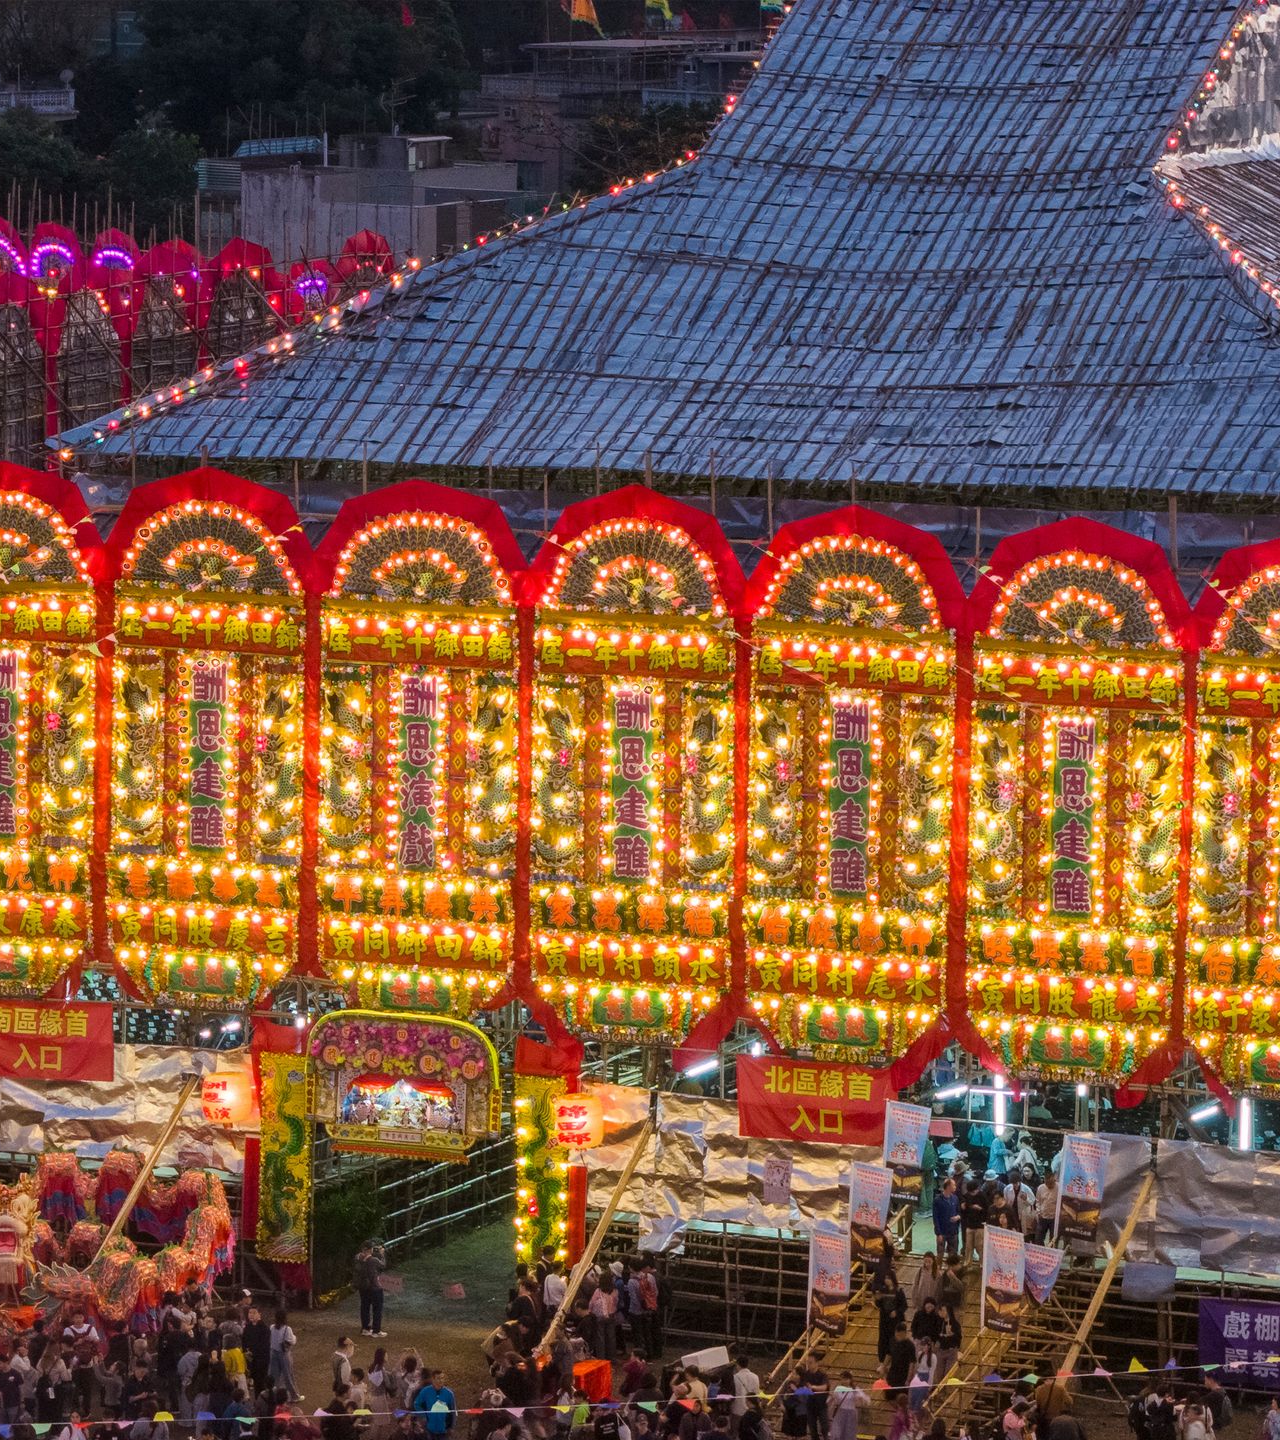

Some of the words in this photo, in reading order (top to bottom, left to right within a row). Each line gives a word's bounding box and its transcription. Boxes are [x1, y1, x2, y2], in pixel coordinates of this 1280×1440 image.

[190, 664, 226, 847] 酬恩建醮
[399, 677, 439, 867] 酬恩演戲
[614, 691, 653, 878] 酬恩建醮
[830, 701, 870, 893] 酬恩建醮
[1053, 722, 1095, 913] 酬恩建醮
[13, 1044, 63, 1072] 入口
[765, 1066, 873, 1100] 北區緣首
[791, 1106, 843, 1135] 入口
